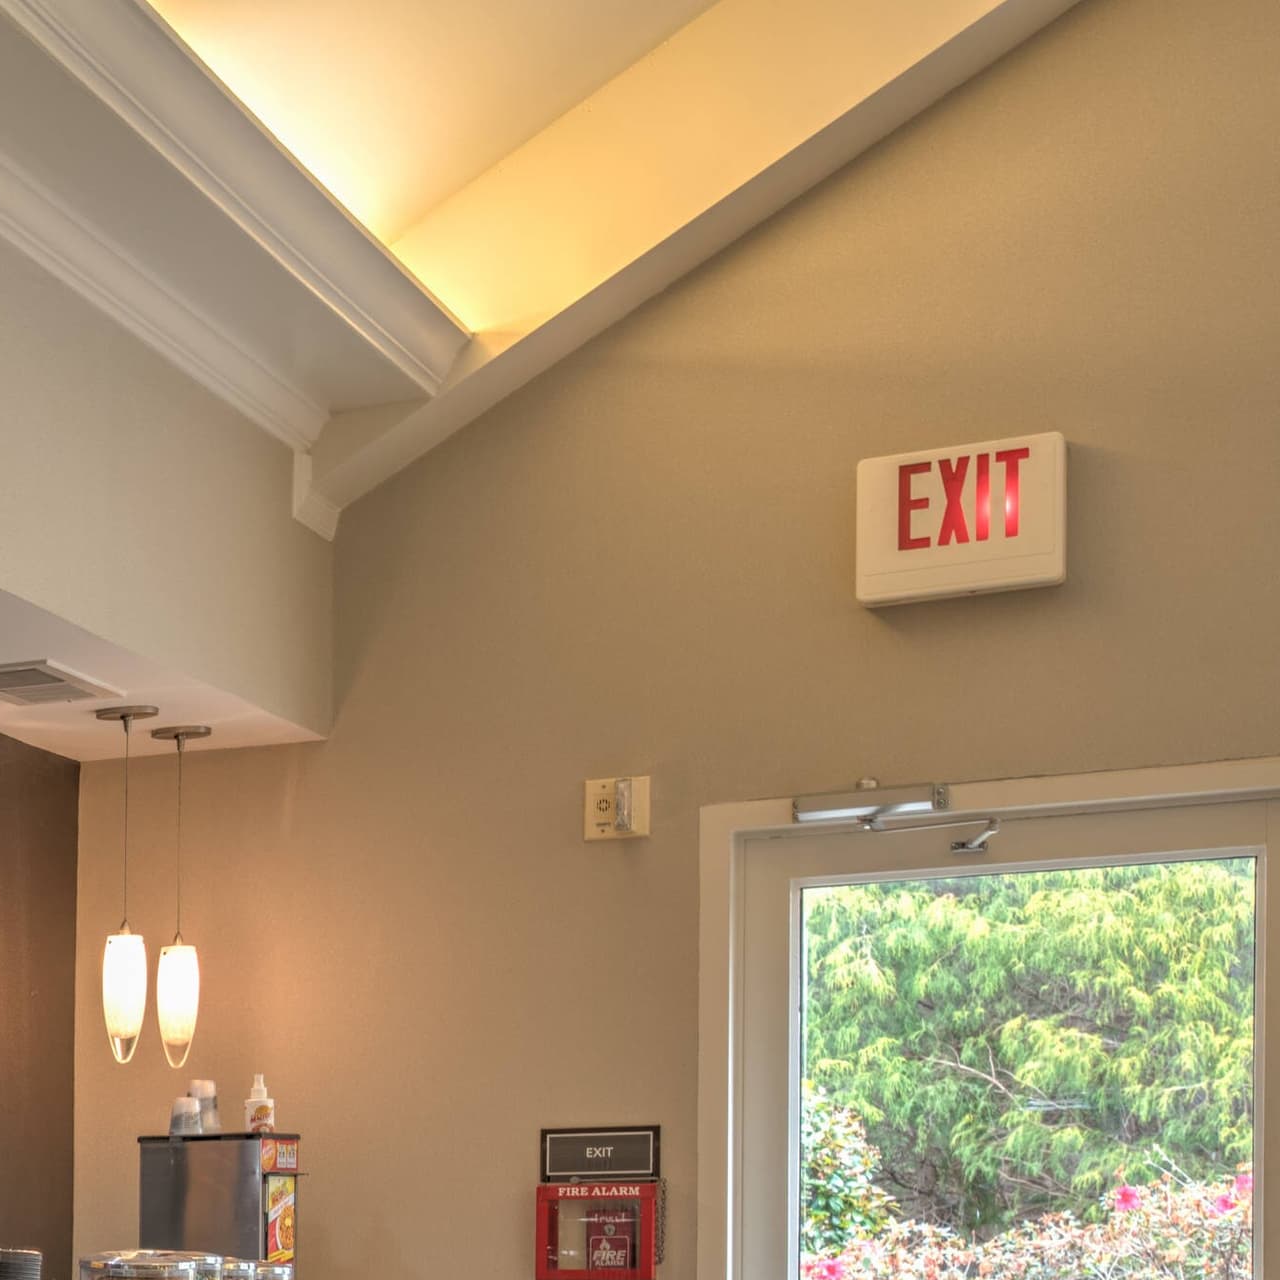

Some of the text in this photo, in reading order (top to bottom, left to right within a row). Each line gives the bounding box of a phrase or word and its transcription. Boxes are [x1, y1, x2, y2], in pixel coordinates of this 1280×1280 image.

[898, 447, 1030, 550] EXIT
[586, 1147, 613, 1158] EXIT
[558, 1186, 640, 1196] FIRE ALARM
[593, 1250, 626, 1261] FIRE
